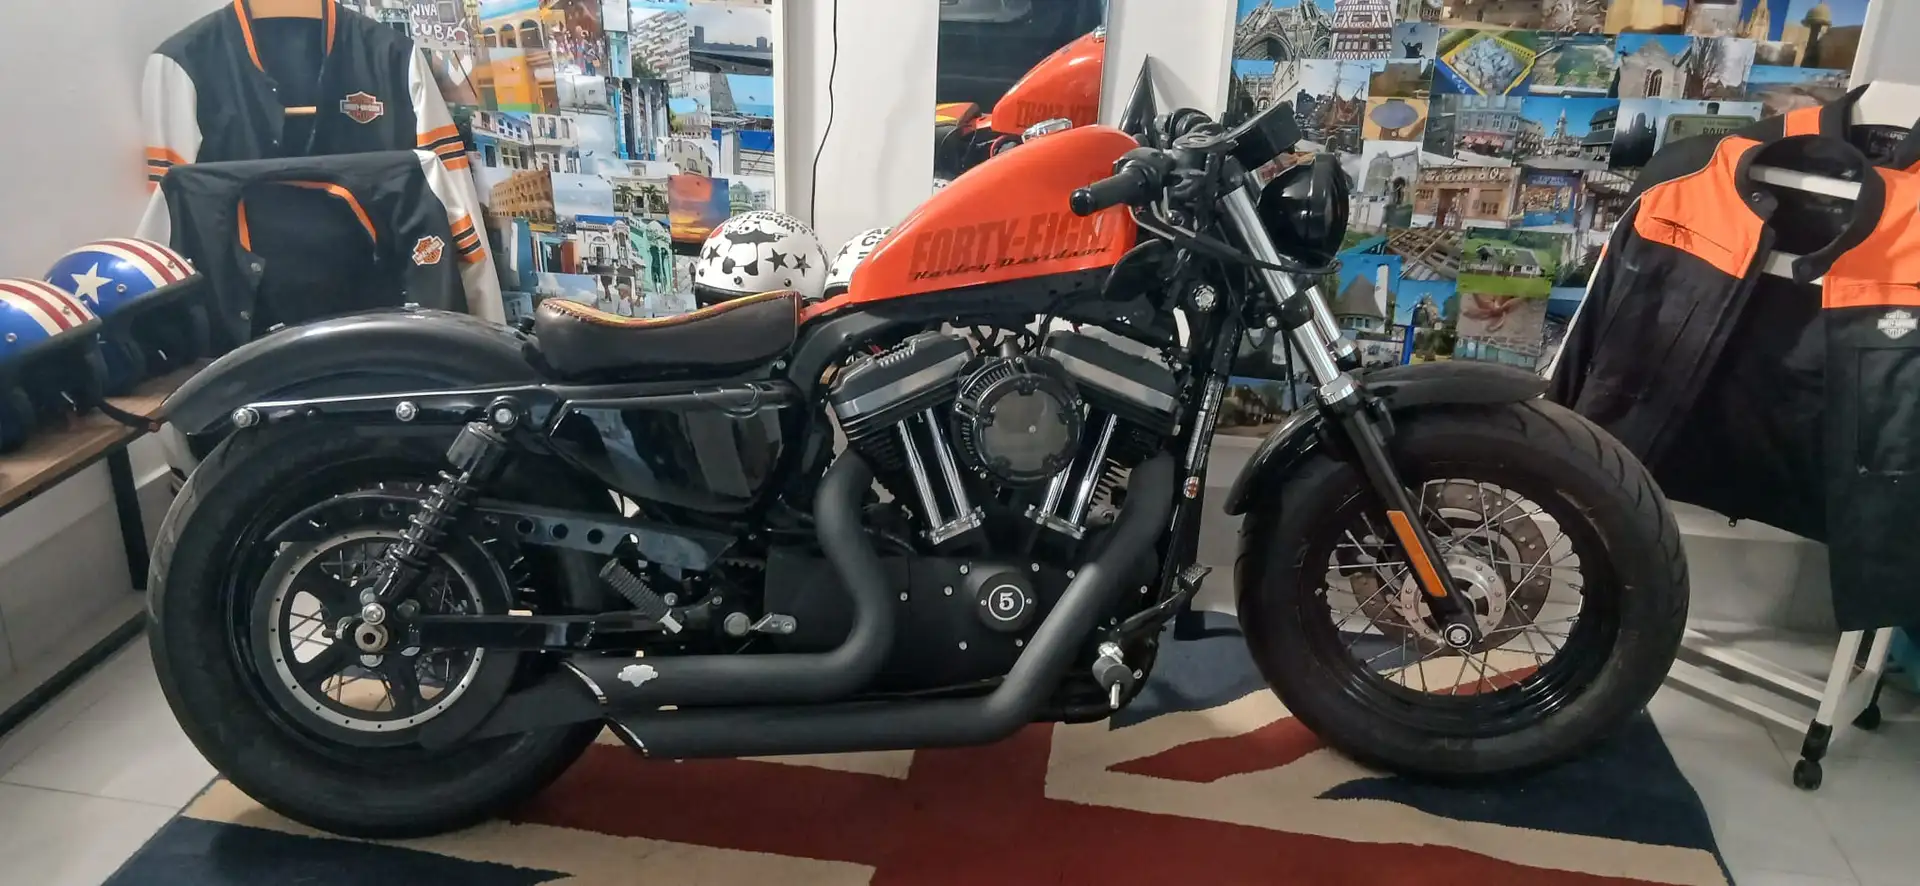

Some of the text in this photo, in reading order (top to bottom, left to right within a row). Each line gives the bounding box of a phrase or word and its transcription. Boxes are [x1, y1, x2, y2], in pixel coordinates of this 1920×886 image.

[411, 4, 438, 17] VIVA
[907, 211, 1116, 282] FORTY-EIGH
[999, 592, 1014, 611] 5
